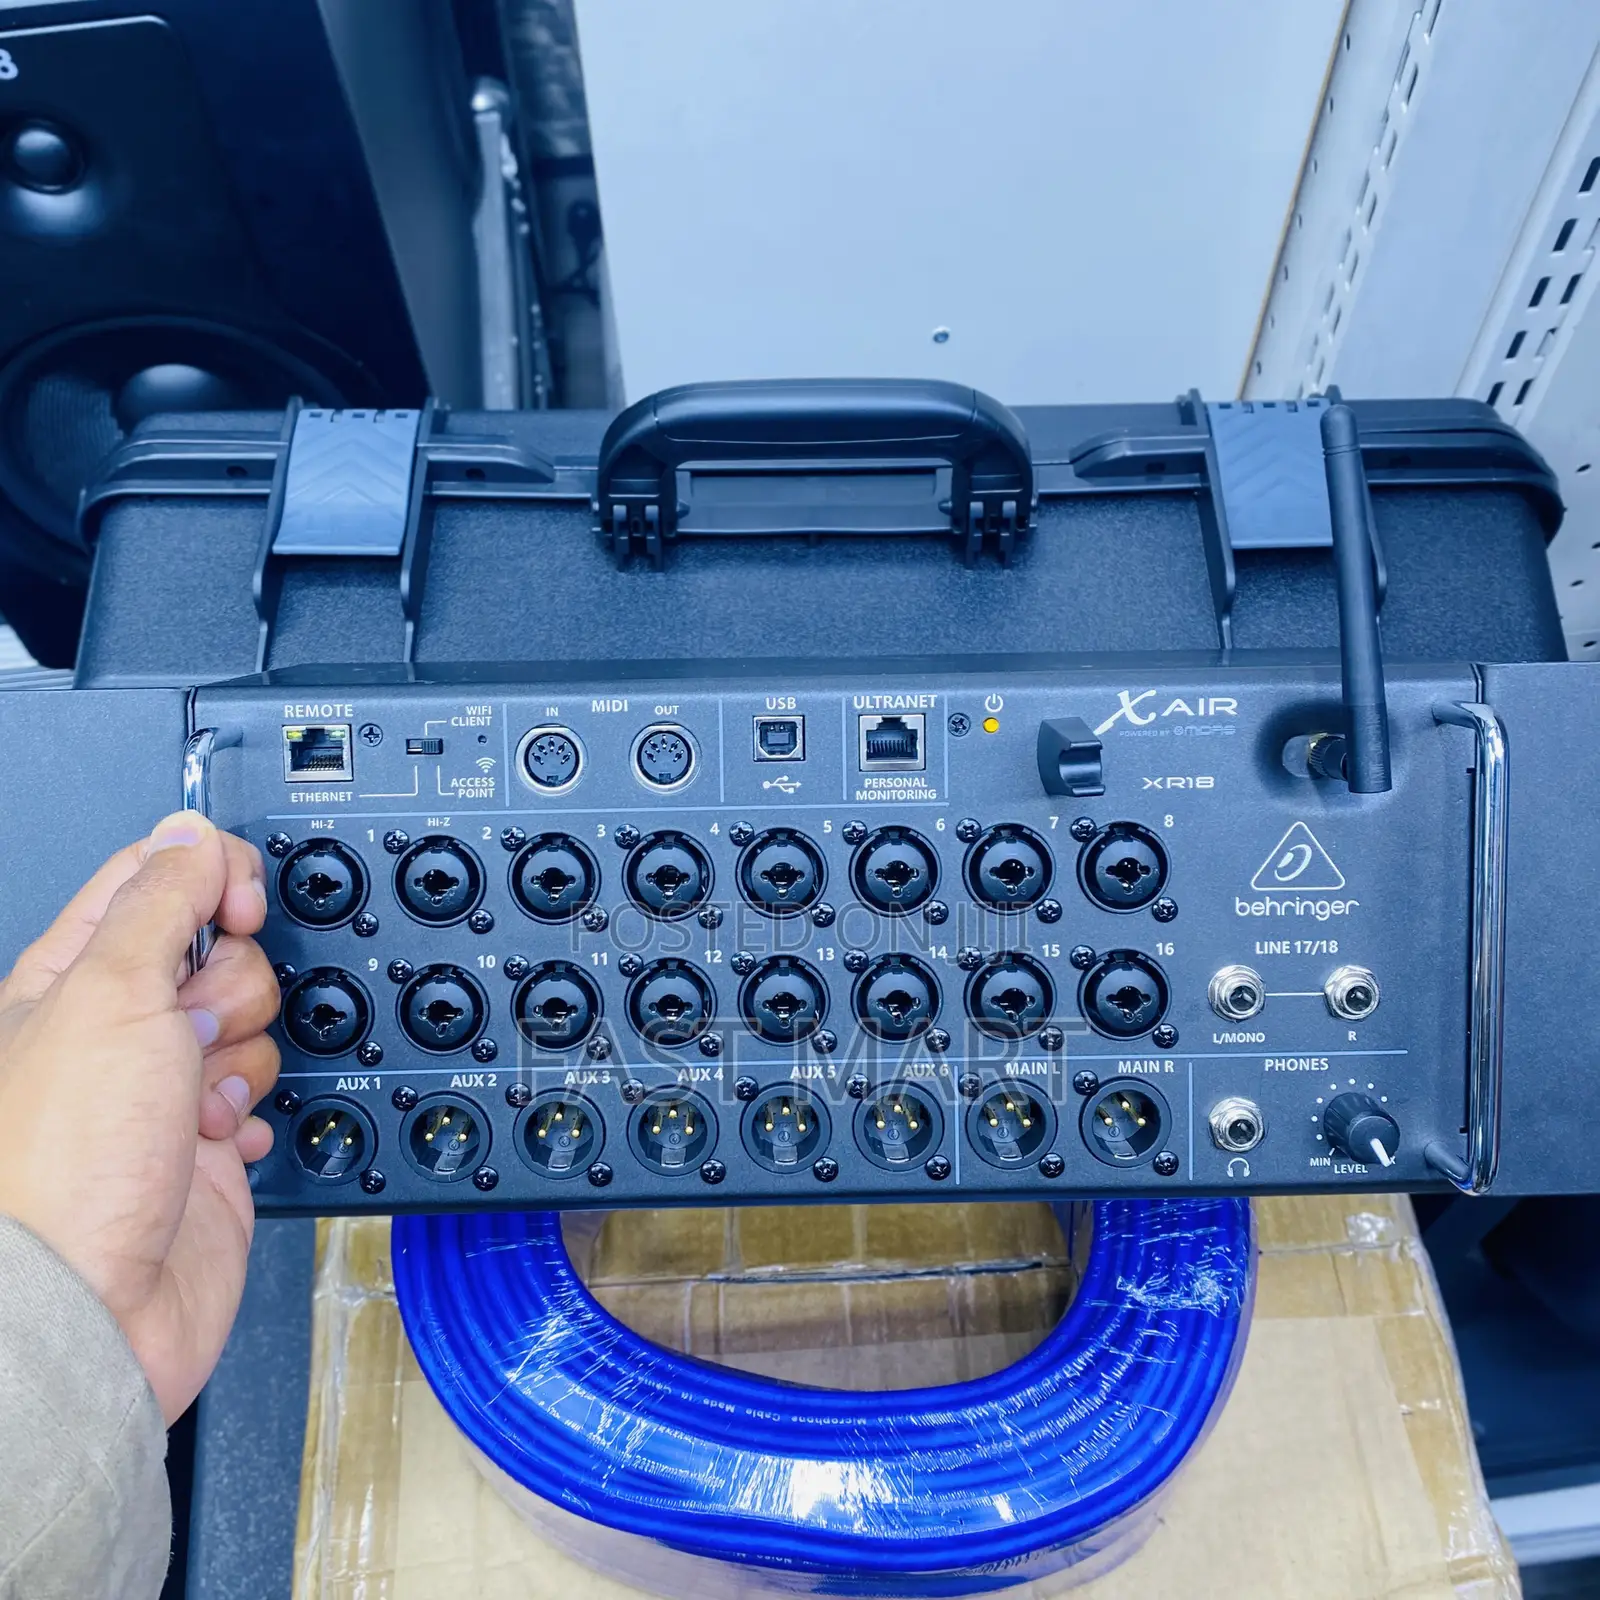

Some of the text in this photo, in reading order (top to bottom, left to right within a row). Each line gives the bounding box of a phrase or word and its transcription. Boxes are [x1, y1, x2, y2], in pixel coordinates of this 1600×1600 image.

[591, 699, 629, 713] MIDI
[765, 696, 797, 710] USB
[853, 694, 938, 709] ULTRANET
[1161, 697, 1238, 717] AIR
[284, 703, 354, 718] REMOTE
[466, 705, 492, 716] WIFI
[545, 706, 559, 717] IN
[654, 704, 680, 716] OUT
[451, 715, 493, 727] CLIENT
[451, 777, 495, 788] ACCESS
[864, 777, 928, 789] PERSONAL
[1142, 776, 1215, 790] XR18
[291, 791, 353, 803] ETHERNET
[458, 787, 495, 799] POINT
[856, 789, 937, 801] MONITORING
[311, 819, 335, 829] HI-Z
[428, 817, 451, 827] HI-Z
[823, 820, 832, 834] 5
[936, 818, 946, 832] 6
[1049, 816, 1059, 830] 7
[1164, 814, 1174, 828] 8
[482, 826, 492, 840] 2
[596, 824, 606, 838] 3
[710, 822, 720, 836] 4
[367, 829, 375, 843] 1
[1235, 896, 1360, 921] behringer
[929, 946, 947, 959] 14
[1042, 944, 1060, 957] 15
[1156, 942, 1174, 956] 16
[1255, 940, 1338, 955] LINE 17/18
[591, 952, 607, 965] 11
[705, 950, 722, 963] 12
[817, 948, 834, 961] 13
[368, 958, 378, 971] 9
[478, 955, 496, 968] 10
[1213, 1033, 1265, 1044] L/MONO
[1348, 1031, 1357, 1041] R
[903, 1063, 949, 1077] AUX 6
[1005, 1061, 1060, 1075] MAIN L
[1118, 1060, 1174, 1073] MAIN R
[1264, 1058, 1329, 1072] PHONES
[564, 1071, 611, 1084] AUX 3
[677, 1067, 724, 1081] AUX 4
[790, 1065, 836, 1079] AUX 5
[336, 1077, 381, 1090] AUX 1
[450, 1074, 497, 1087] AUX 2
[1310, 1157, 1331, 1167] MIN
[1334, 1163, 1368, 1174] LEVEL
[703, 1398, 735, 1414] Made
[745, 1407, 781, 1422] Cable
[791, 1414, 867, 1426] Microphone
